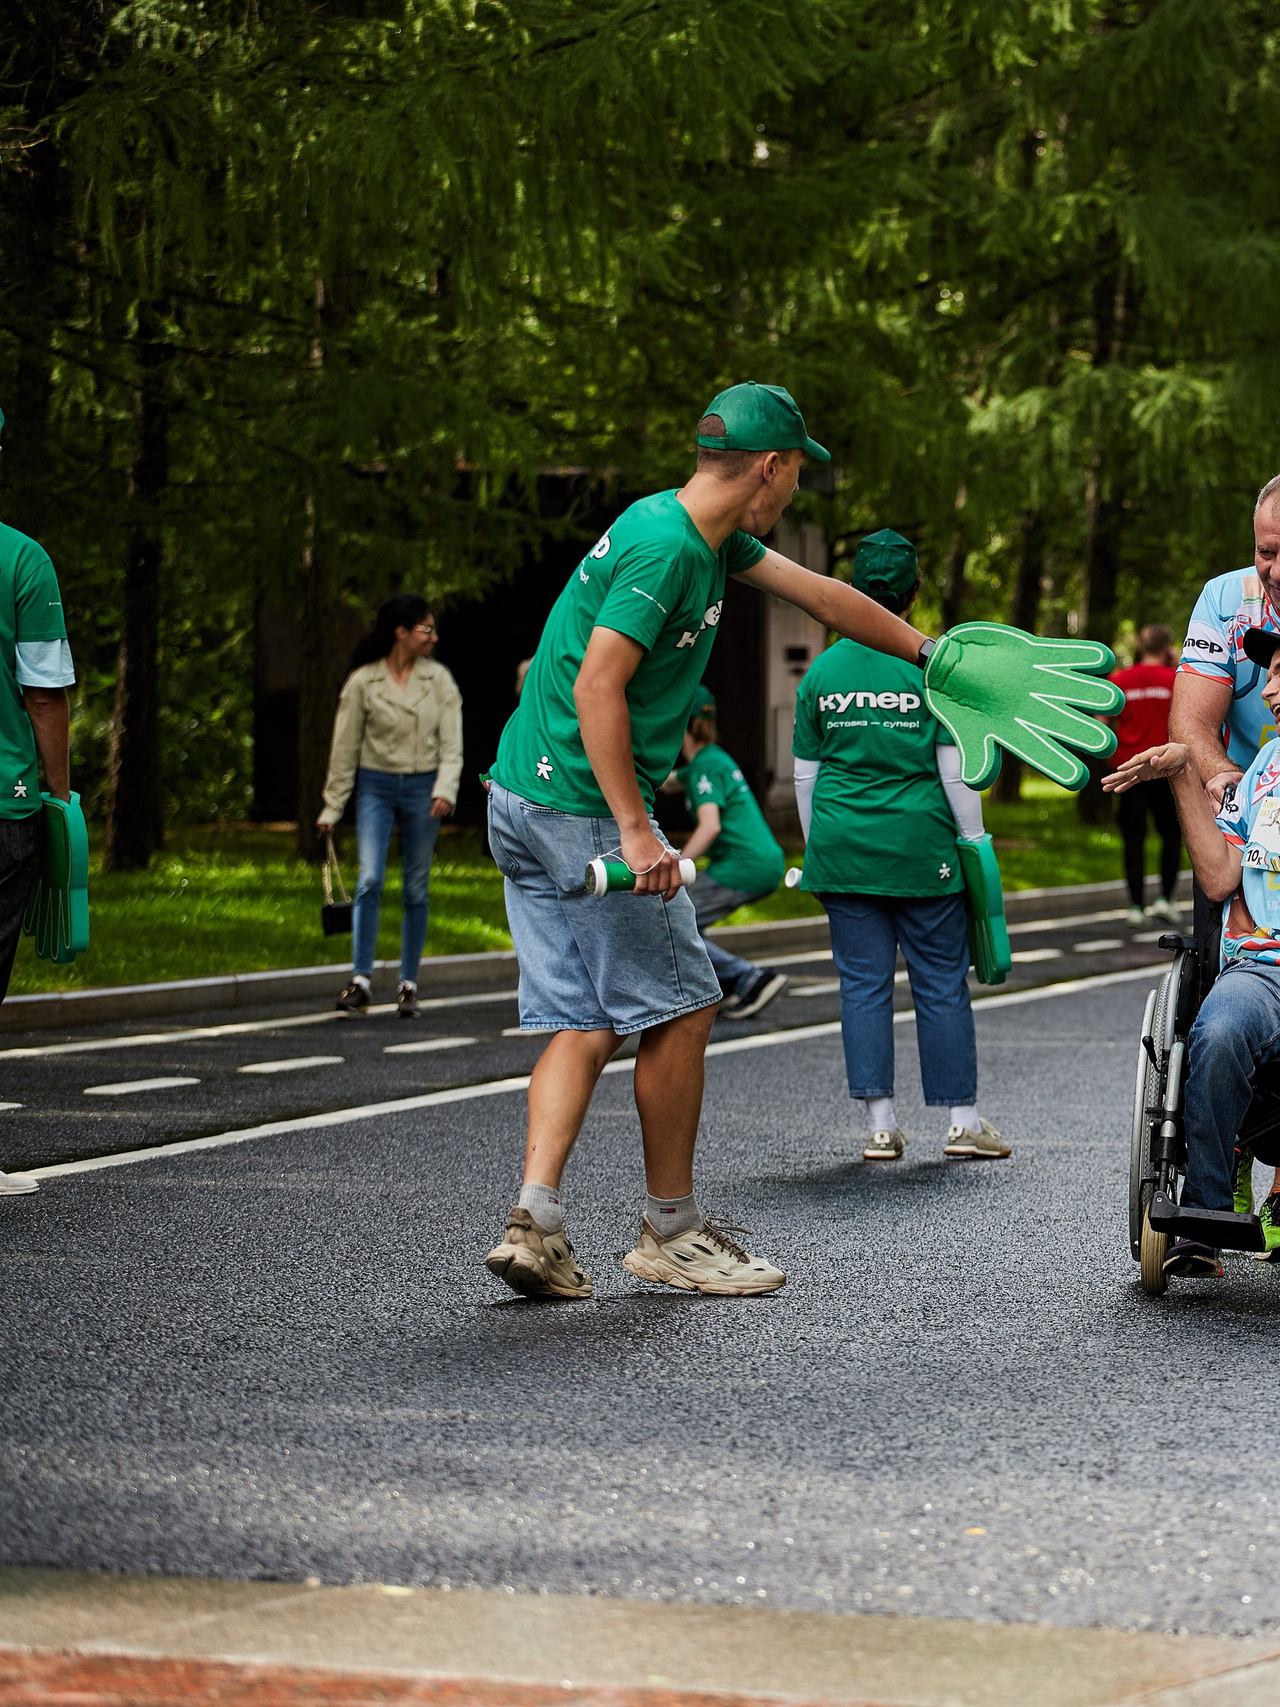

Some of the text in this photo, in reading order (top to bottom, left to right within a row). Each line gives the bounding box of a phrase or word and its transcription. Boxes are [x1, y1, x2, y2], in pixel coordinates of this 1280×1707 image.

[1182, 637, 1224, 655] пер
[818, 690, 921, 714] купер
[883, 721, 920, 729] супер!
